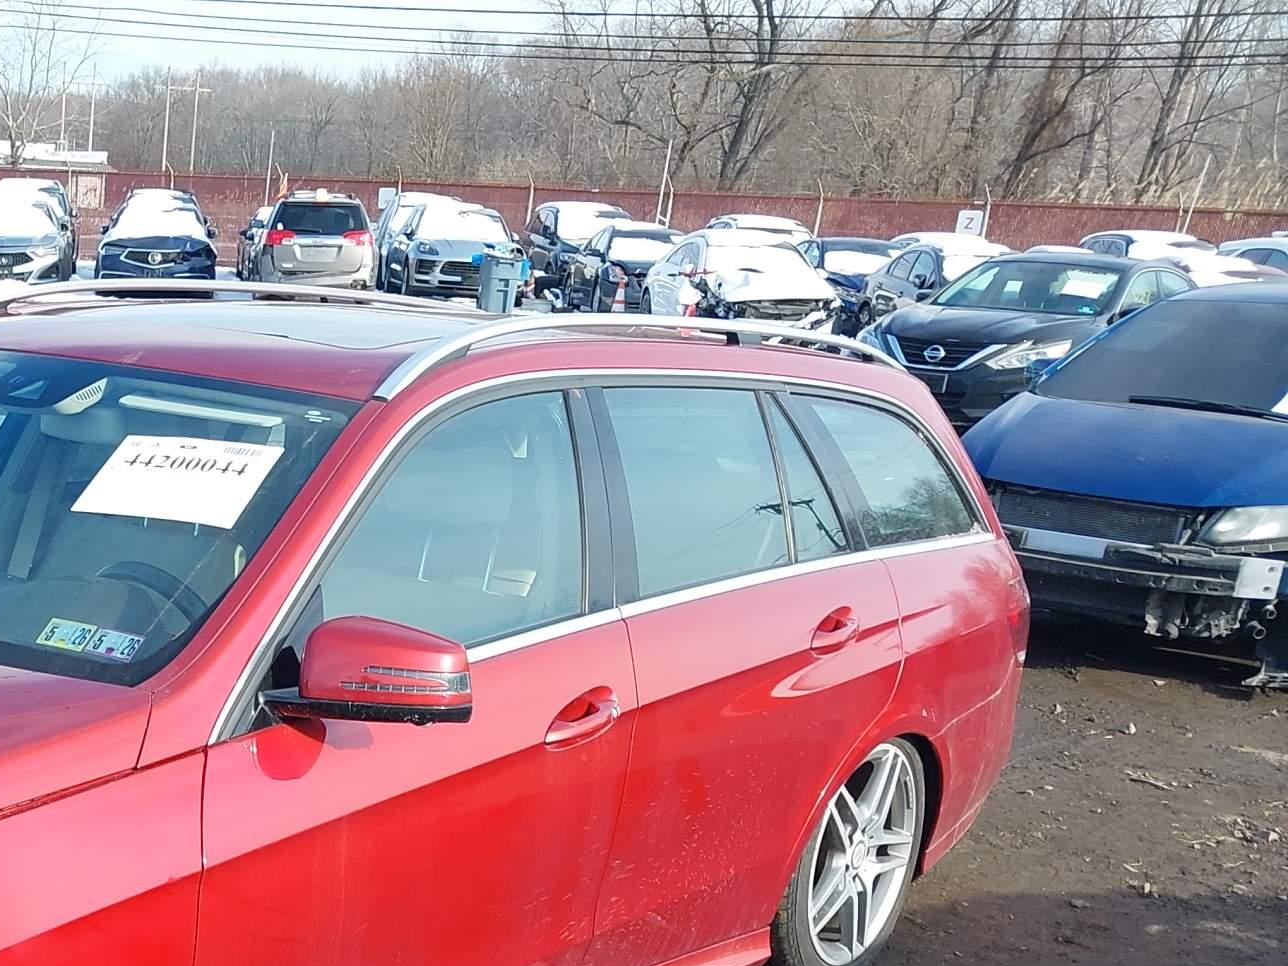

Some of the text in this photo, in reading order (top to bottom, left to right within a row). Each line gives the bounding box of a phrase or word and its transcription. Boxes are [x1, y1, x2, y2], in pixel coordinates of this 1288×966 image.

[964, 217, 975, 230] Z
[124, 453, 249, 477] 44200044
[72, 628, 92, 646] 26
[120, 638, 141, 656] 26
